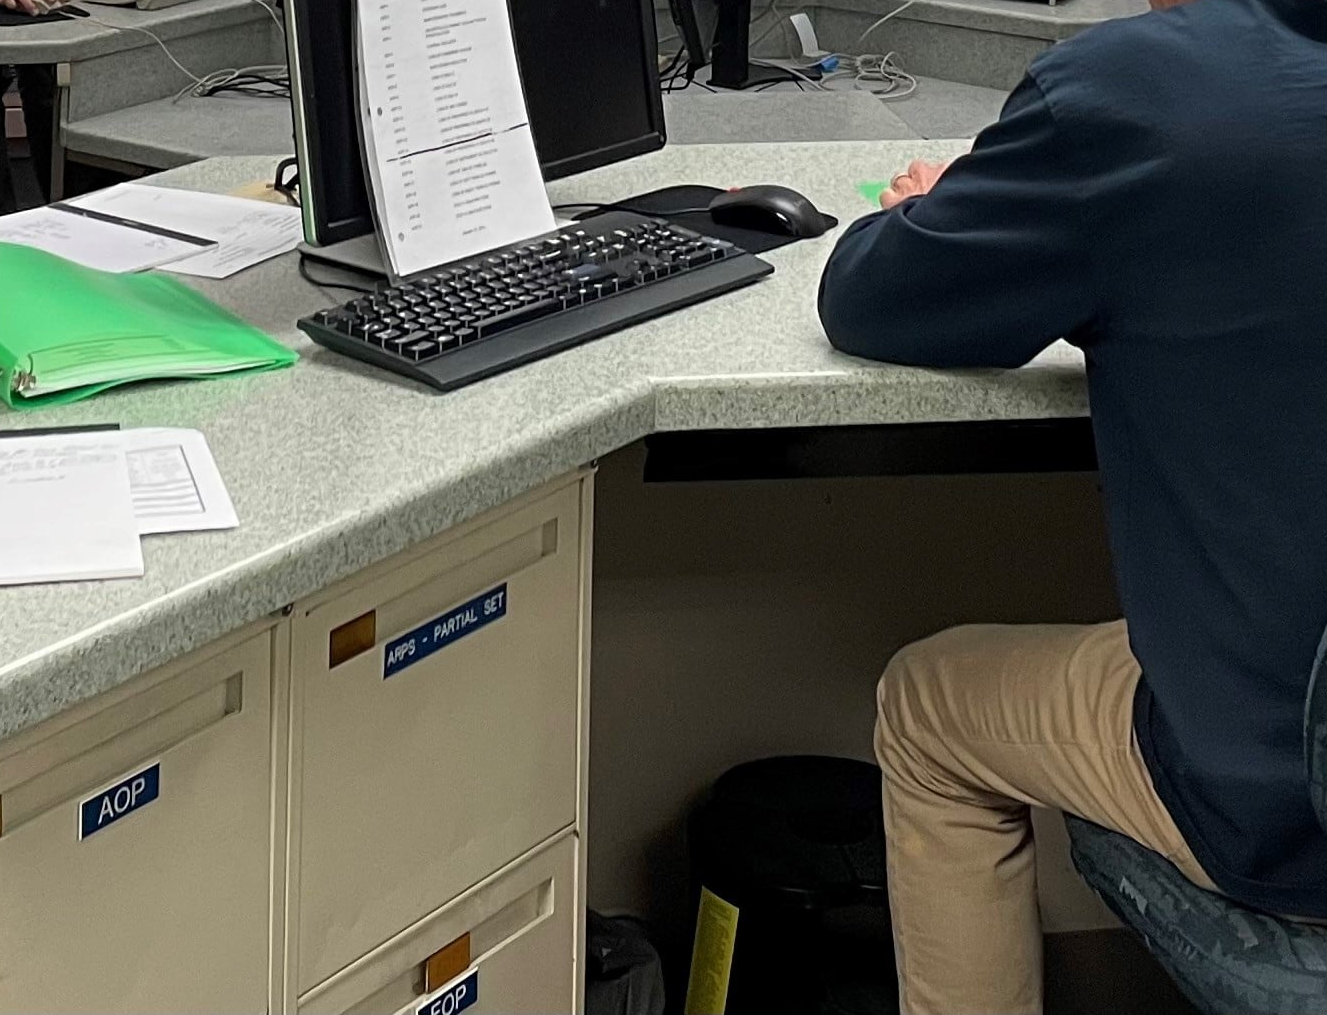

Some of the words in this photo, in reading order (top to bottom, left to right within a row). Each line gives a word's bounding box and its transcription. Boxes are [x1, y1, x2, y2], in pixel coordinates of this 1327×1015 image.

[386, 638, 416, 667] ARPS
[433, 608, 478, 643] PARTIAL
[483, 591, 504, 615] SET
[97, 777, 145, 825] AOP
